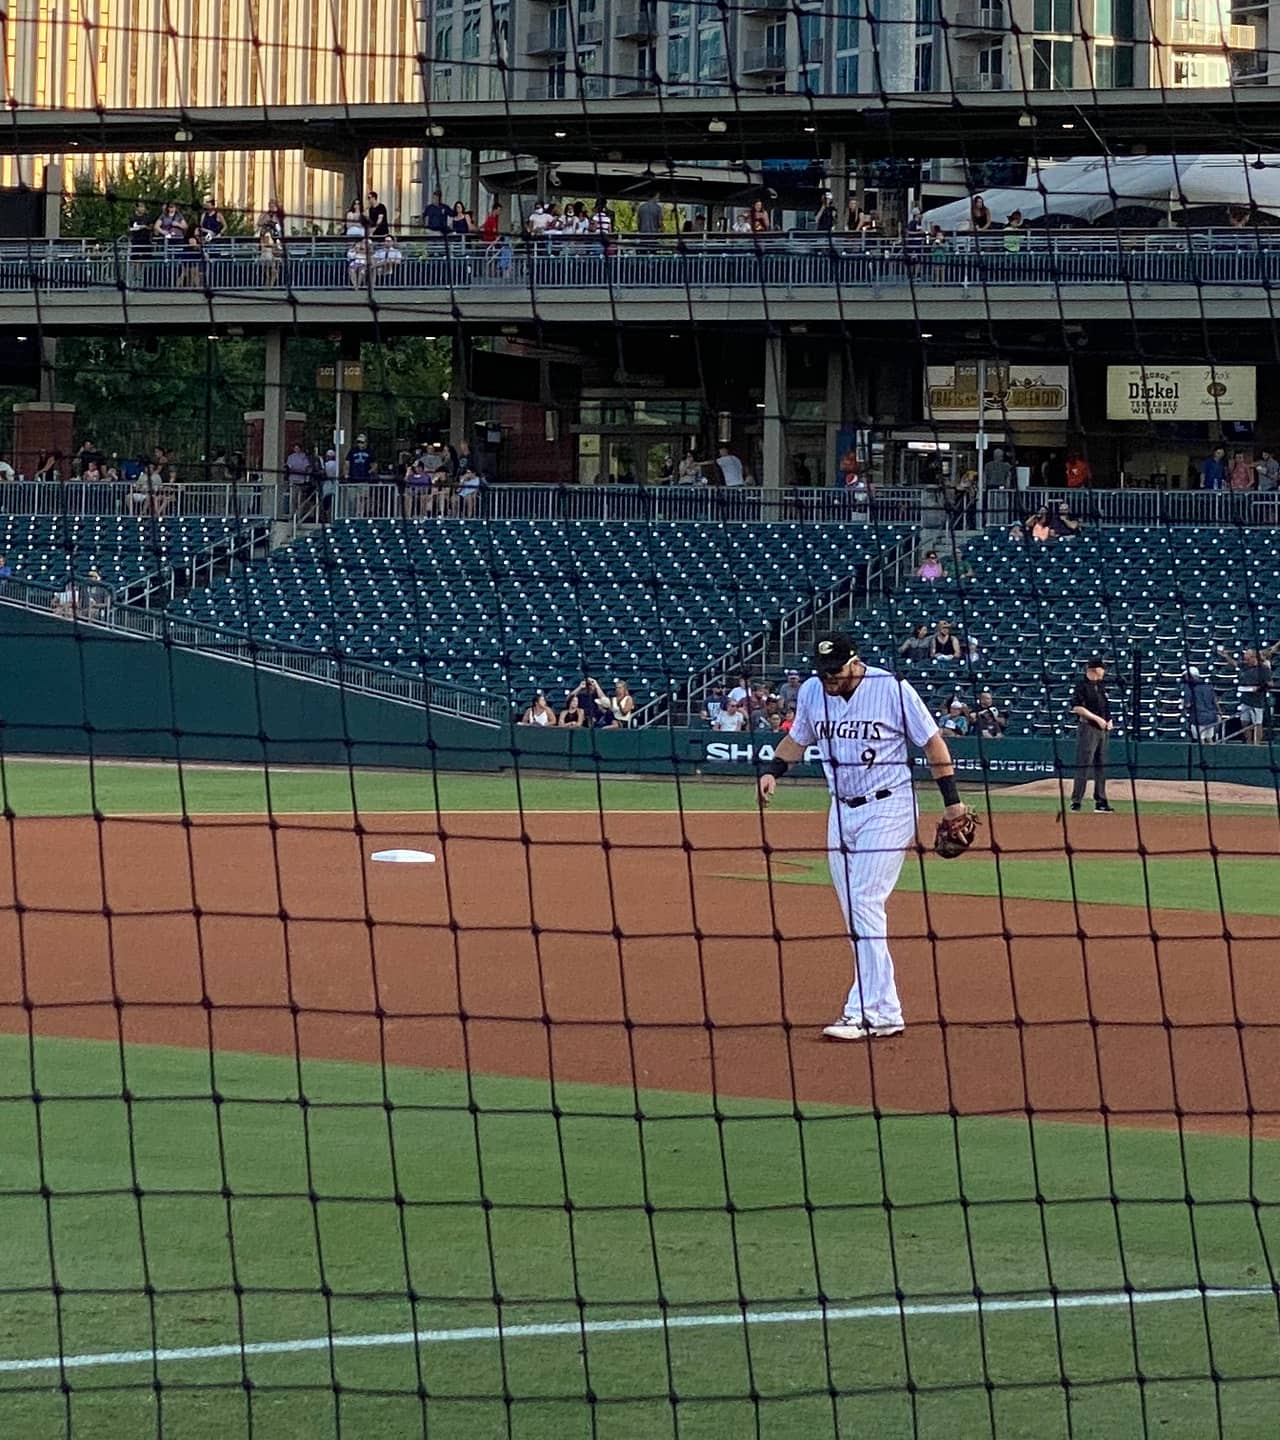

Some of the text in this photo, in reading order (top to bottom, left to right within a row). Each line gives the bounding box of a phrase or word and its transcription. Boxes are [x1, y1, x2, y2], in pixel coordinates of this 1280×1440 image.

[1128, 382, 1179, 399] Dickel
[1131, 400, 1178, 408] TENESSEE
[705, 742, 826, 763] SHAP
[860, 747, 877, 771] 9
[989, 759, 1055, 772] SYSTEMS
